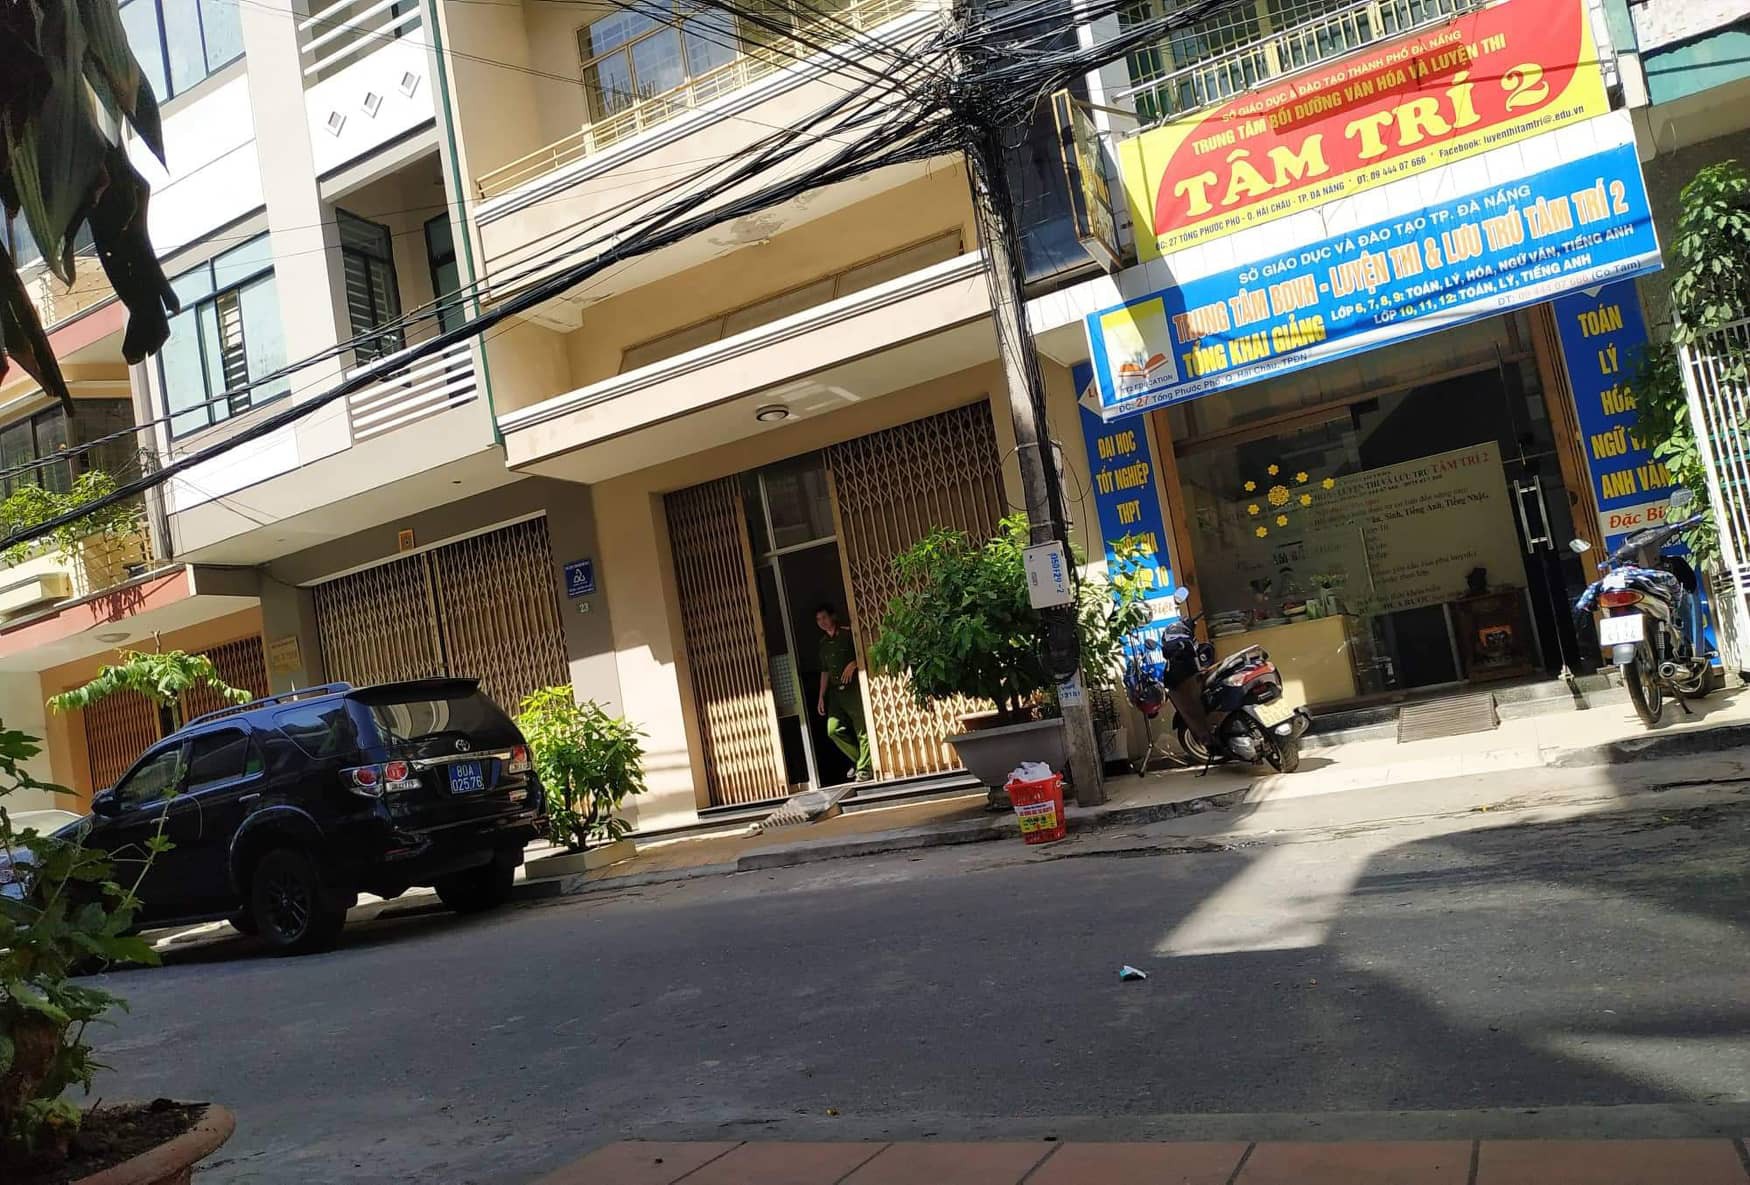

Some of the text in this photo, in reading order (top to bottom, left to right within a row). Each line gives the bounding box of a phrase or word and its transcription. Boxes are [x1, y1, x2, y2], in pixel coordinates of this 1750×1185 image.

[1192, 33, 1507, 155] TRUNG TÂM BỒI DƯỠNG VĂN HÓA VÀ LUYỆN THI
[1238, 102, 1263, 116] GIÁO
[1265, 94, 1288, 106] DỤC
[1347, 59, 1384, 77] THÀNH
[1174, 133, 1330, 217] TÂM
[1344, 71, 1480, 160] TRÍ
[1501, 62, 1550, 112] 2
[1169, 236, 1177, 247] 27
[1382, 164, 1397, 177] 444
[1398, 160, 1409, 171] 07
[1439, 138, 1481, 158] Facebook:
[1238, 265, 1260, 284] SỞ
[1262, 256, 1298, 276] GIÁO
[1300, 246, 1332, 268] DỤC
[1334, 236, 1355, 254] VÀ
[1358, 227, 1391, 247] ĐÀO
[1394, 216, 1426, 235] TẠO
[1429, 208, 1454, 224] TP.
[1456, 198, 1480, 217] ĐÀ
[1173, 302, 1231, 344] TRUNG
[1229, 288, 1270, 328] TÂM
[1268, 274, 1319, 316] BDVH
[1329, 250, 1390, 298] LUYỆN
[1388, 240, 1423, 280] THI
[1424, 237, 1444, 270] &
[1523, 196, 1573, 240] TÂM
[1571, 177, 1610, 225] TRÍ
[1609, 180, 1629, 215] 2
[1331, 224, 1634, 321] LỚP 6, 7, 8, 9: TOÁN, LÝ, HÓA, NGỮ VĂN, TIẾNG ANH
[1374, 253, 1592, 324] LỚP 10, 11, 12: TOÁN, LÝ, TIẾNG ANH
[1578, 304, 1624, 338] TOÁN
[1182, 313, 1327, 379] TỔNG KHAI GIẢNG
[1598, 343, 1618, 375] LÝ
[1135, 396, 1149, 408] 27
[1601, 384, 1637, 416] HÓA
[1098, 430, 1136, 462] ĐẠI HỌC
[1591, 425, 1627, 459] NGỮ
[1096, 459, 1149, 495] TỐT NGHIỆP
[1601, 460, 1672, 499] ANH VĂN
[1116, 500, 1141, 525] THPT
[1610, 512, 1641, 528] Đặc
[1155, 565, 1169, 588] 10
[457, 765, 473, 778] 80A
